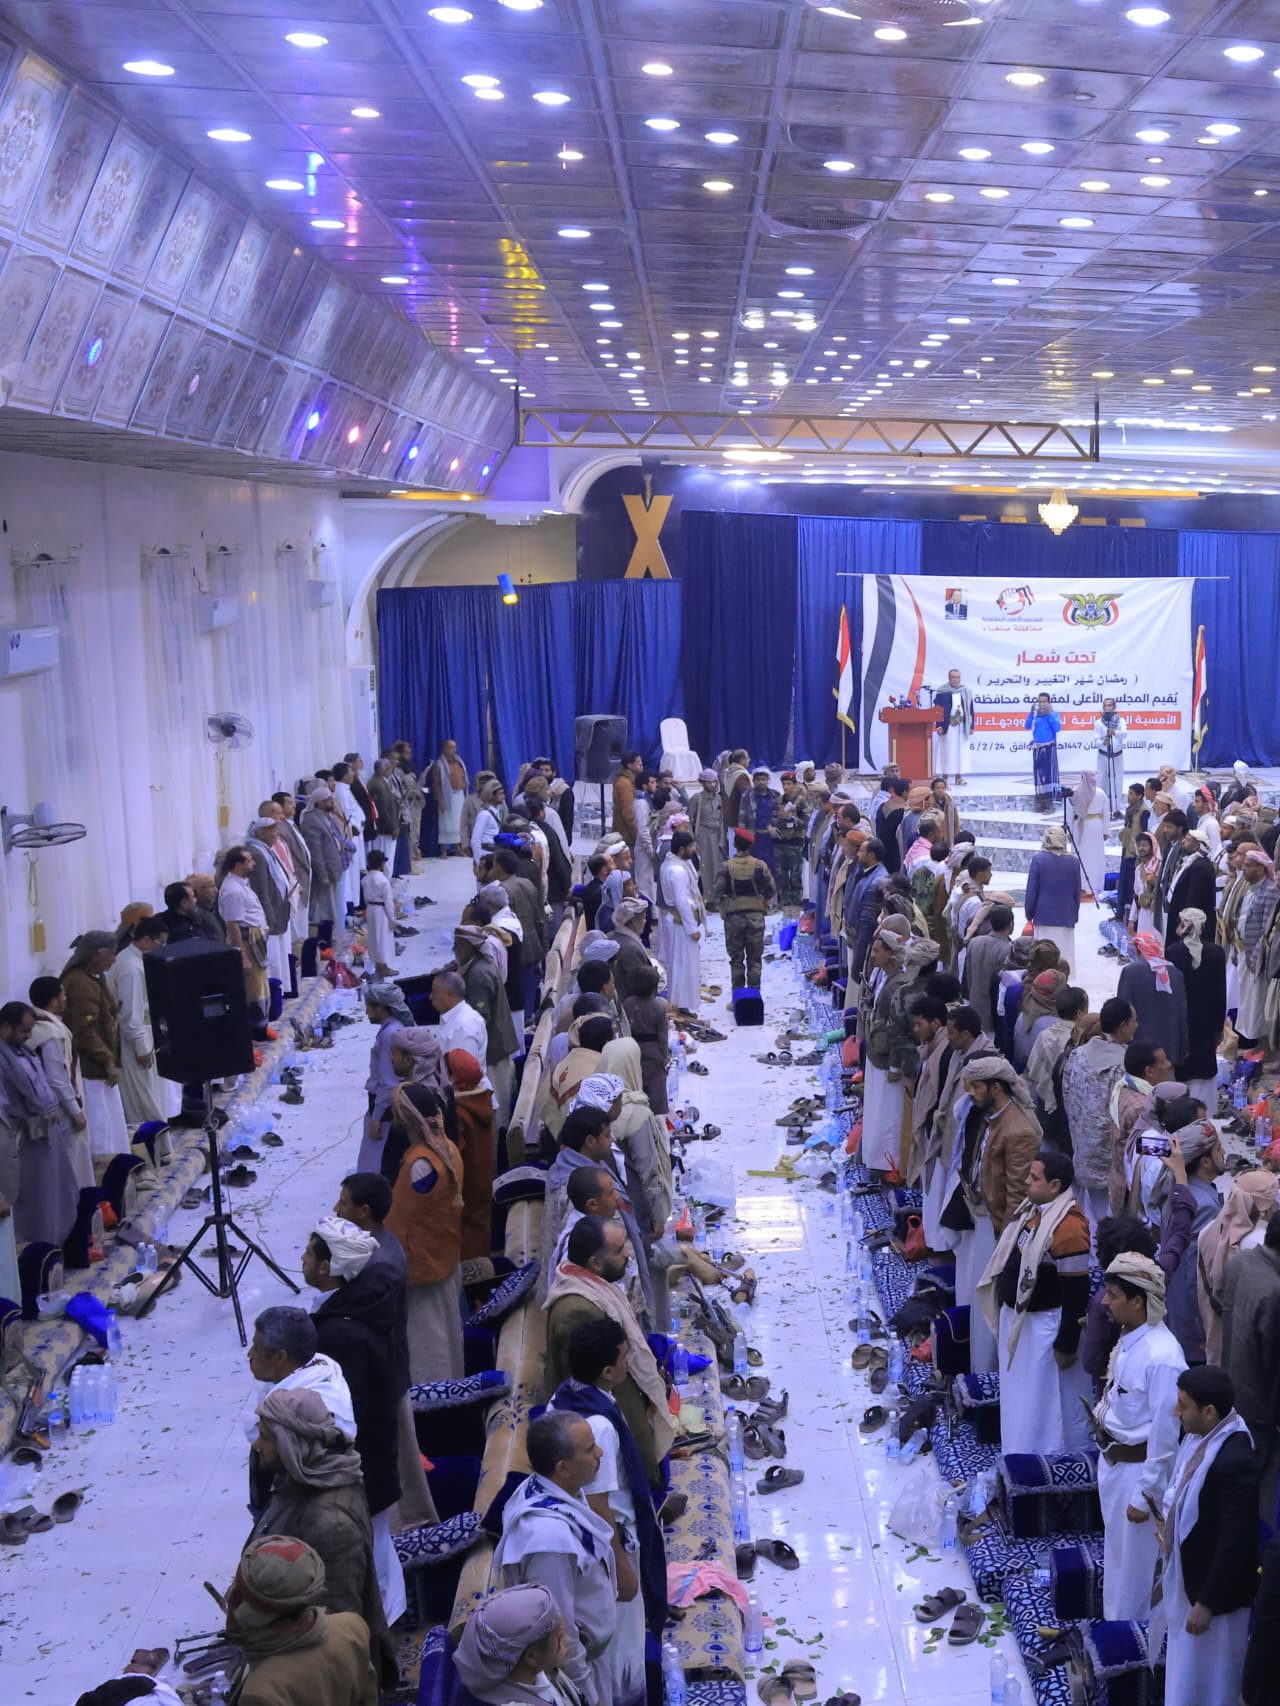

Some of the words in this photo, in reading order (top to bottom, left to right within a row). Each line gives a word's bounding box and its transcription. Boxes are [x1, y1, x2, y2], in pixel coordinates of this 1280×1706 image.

[1016, 649, 1060, 666] شعار
[1065, 651, 1097, 664] تحت
[987, 674, 1030, 686] والتحرير
[1035, 674, 1070, 686] التغيير
[1074, 674, 1094, 685] شهر
[1097, 673, 1127, 685] رمضان
[974, 693, 1020, 704] محافظة
[1023, 693, 1070, 704] لمقمة
[1073, 692, 1103, 705] الأعلى
[1135, 714, 1176, 727] الأمسية
